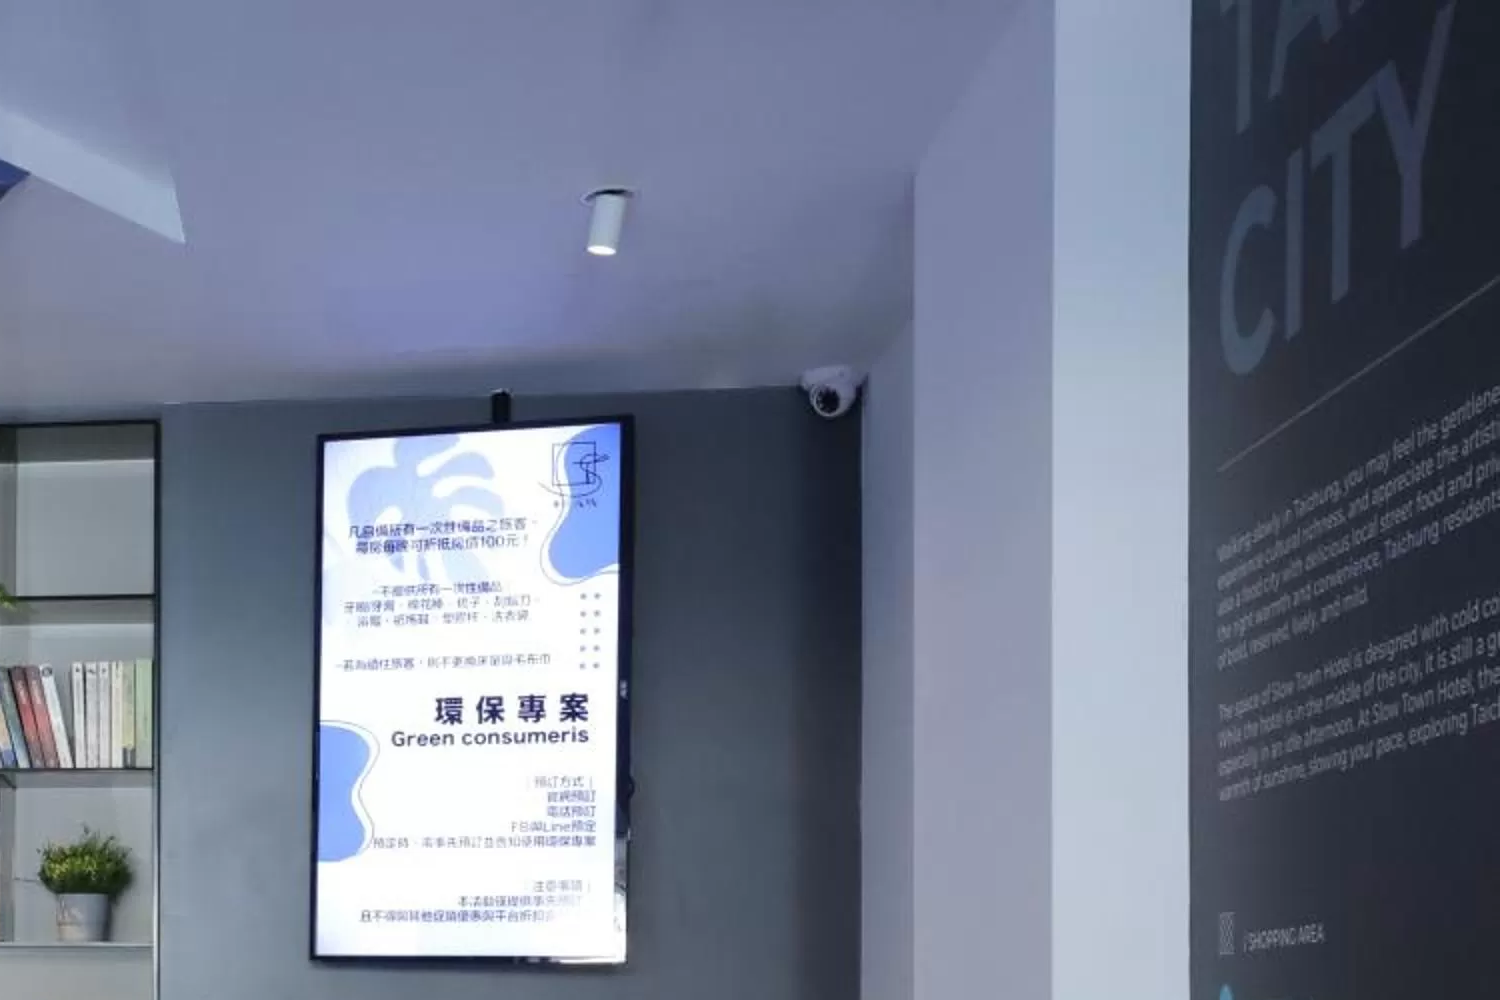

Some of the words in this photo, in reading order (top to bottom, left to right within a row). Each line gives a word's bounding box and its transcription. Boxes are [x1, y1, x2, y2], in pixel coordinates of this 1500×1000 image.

[1220, 0, 1364, 134] TA
[1220, 0, 1455, 376] CITY
[1343, 468, 1365, 497] you
[1366, 450, 1390, 478] may
[1393, 430, 1415, 461] feel
[1417, 422, 1438, 448] the
[1348, 487, 1369, 519] and
[1372, 457, 1434, 510] appreciate
[1436, 444, 1458, 470] the
[1352, 513, 1379, 546] local
[1380, 499, 1414, 533] street
[1416, 479, 1445, 513] food
[1448, 464, 1473, 497] and
[1384, 520, 1440, 561] Taichung
[1352, 649, 1362, 669] is
[1364, 623, 1418, 665] designed
[1420, 612, 1449, 642] with
[1451, 597, 1480, 631] cold
[1363, 672, 1375, 696] of
[1377, 668, 1397, 691] the
[1437, 646, 1448, 670] is
[1449, 635, 1473, 665] still
[1475, 637, 1485, 656] a
[391, 731, 455, 748] Green
[462, 726, 589, 746] consumeris
[435, 692, 589, 725] 環保專案
[1358, 708, 1370, 729] At
[1372, 701, 1399, 725] Slow
[1401, 689, 1435, 714] Town
[1349, 740, 1374, 769] your
[1376, 731, 1407, 760] pace,
[1408, 711, 1468, 746] exploring
[1298, 922, 1327, 945] AREA
